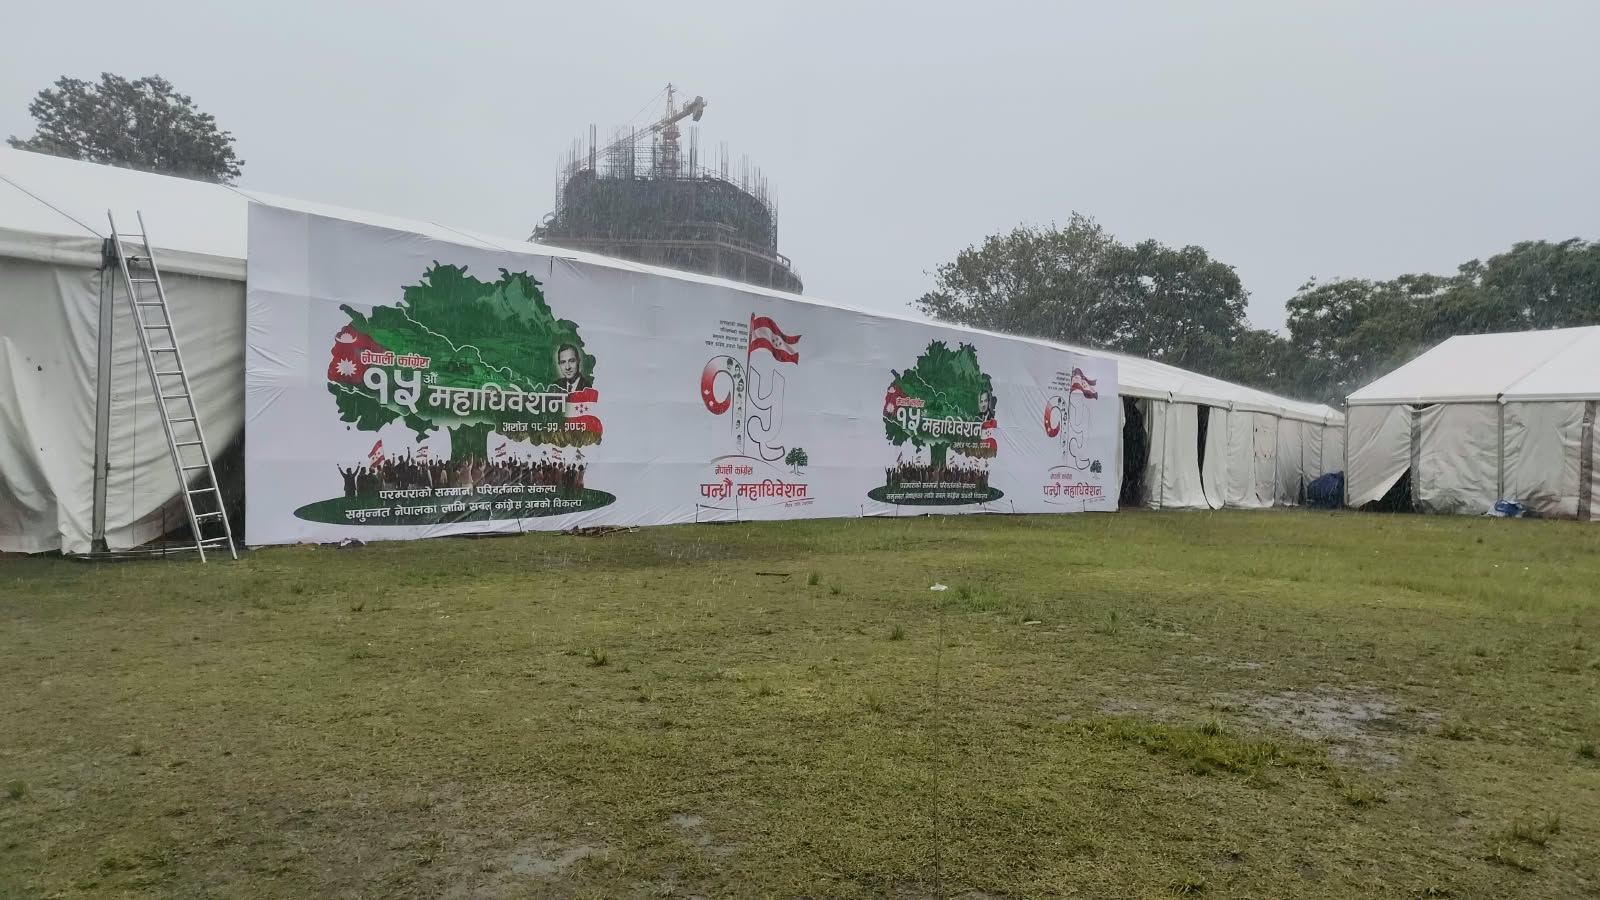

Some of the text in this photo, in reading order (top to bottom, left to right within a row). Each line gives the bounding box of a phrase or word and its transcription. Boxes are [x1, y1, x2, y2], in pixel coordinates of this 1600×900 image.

[361, 350, 431, 369] नेपाली कांग्रेस
[363, 367, 421, 414] १५
[428, 382, 569, 416] महाधिवेशन
[502, 421, 528, 432] असोज
[896, 407, 983, 438] १५ महाधिवेशन
[379, 483, 556, 499] परम्पराको सम्मान, परिवर्तनको संकल्प
[737, 478, 808, 501] महाधिवेशन
[1063, 482, 1102, 498] महाधिवेशन
[345, 507, 391, 522] समुन्नत
[394, 504, 437, 516] नेपालका
[441, 500, 466, 513] लागि
[494, 499, 522, 511] कांग्रेस
[525, 498, 550, 509] अबको
[553, 498, 582, 508] विकल्प
